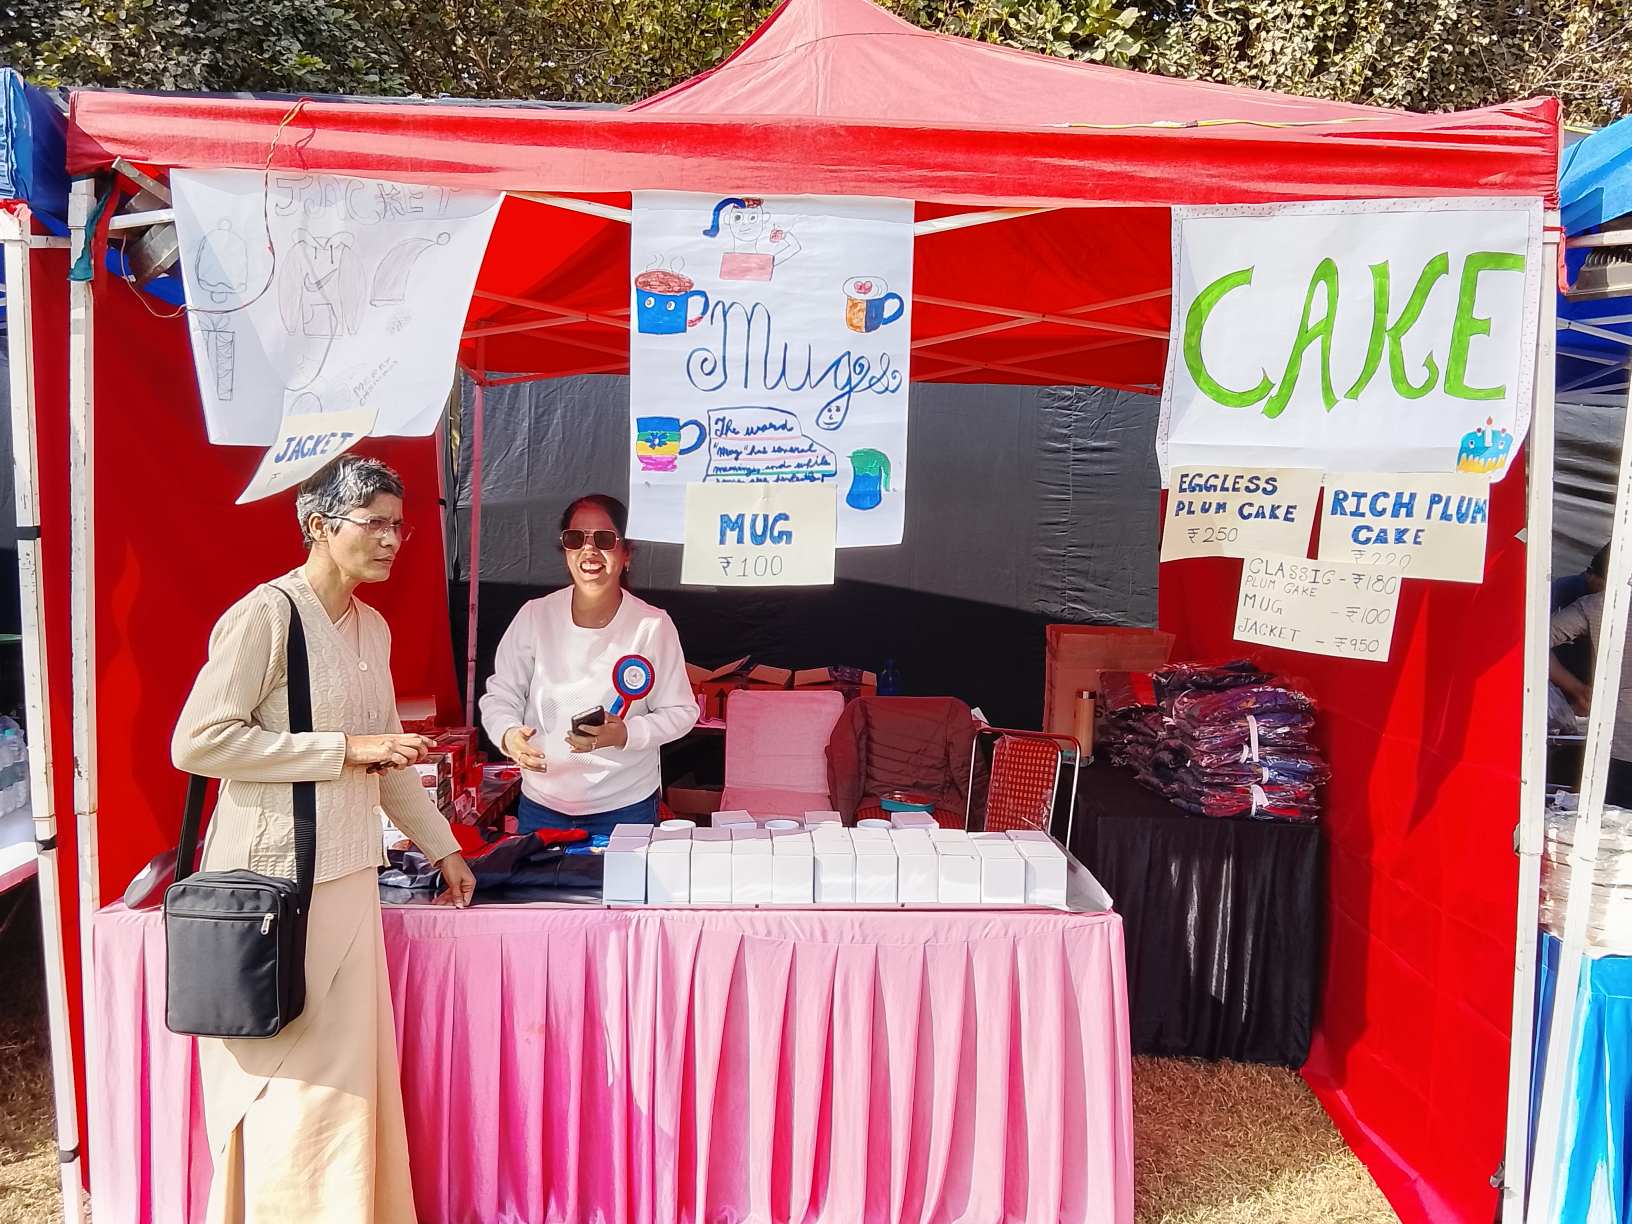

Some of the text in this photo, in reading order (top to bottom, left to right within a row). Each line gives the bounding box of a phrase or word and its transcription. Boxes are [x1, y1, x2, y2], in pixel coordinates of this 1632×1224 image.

[1183, 251, 1526, 420] CAKE
[687, 300, 903, 431] Mugs
[714, 416, 794, 437] The word
[274, 432, 354, 463] JACKET
[1178, 473, 1278, 496] EGGLESS
[1175, 500, 1298, 523] PLUM CAKE
[1330, 489, 1488, 524] RICH PLUM
[719, 513, 794, 546] MUG
[1187, 527, 1239, 543] ₹250
[1351, 525, 1426, 546] CAKE
[718, 555, 784, 577] ₹100
[1245, 575, 1319, 598] PLUM CAKE
[1352, 573, 1397, 595] ₹180
[1243, 593, 1283, 616] MUG
[1346, 606, 1391, 625] ₹100
[1237, 617, 1302, 643] JACKET
[1335, 637, 1380, 653] ₹950
